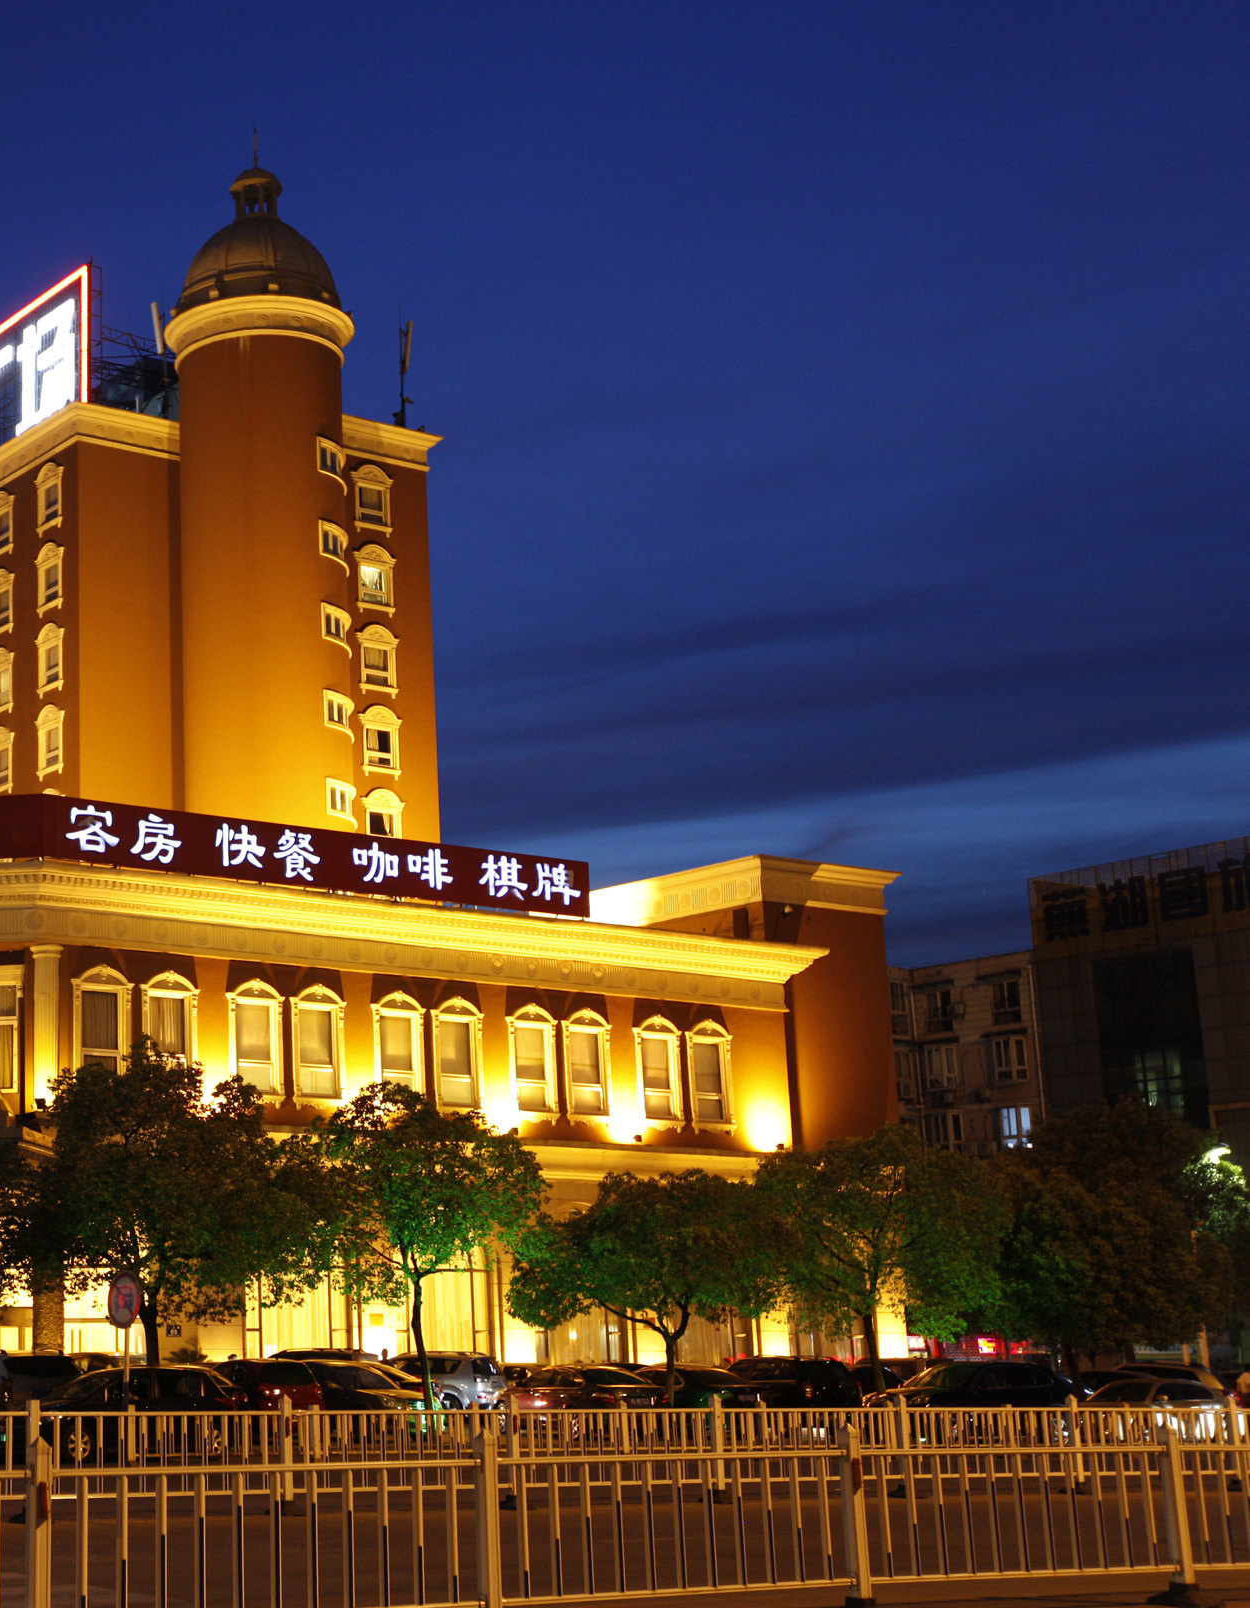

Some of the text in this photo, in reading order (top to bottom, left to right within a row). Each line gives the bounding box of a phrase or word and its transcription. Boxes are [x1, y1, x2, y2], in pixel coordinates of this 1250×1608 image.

[65, 804, 581, 905] 客房 快餐 咖啡 棋牌
